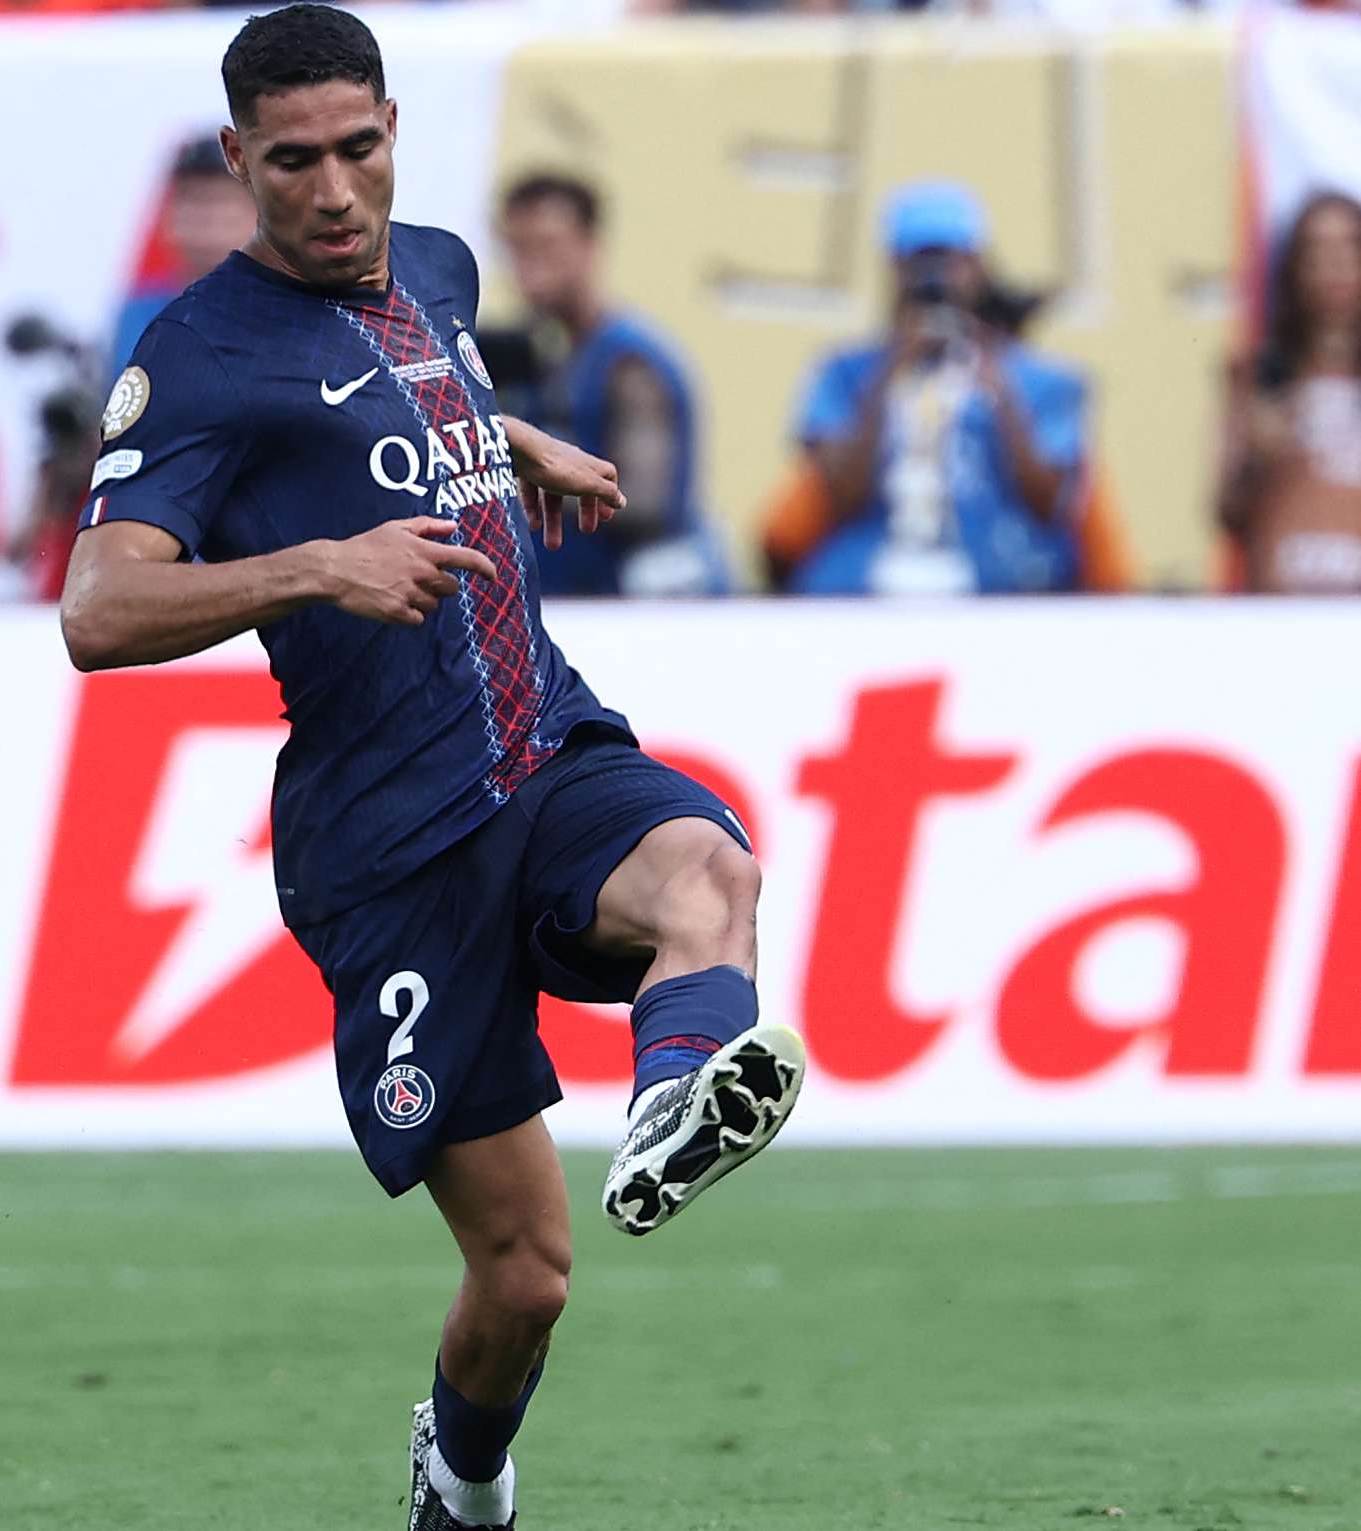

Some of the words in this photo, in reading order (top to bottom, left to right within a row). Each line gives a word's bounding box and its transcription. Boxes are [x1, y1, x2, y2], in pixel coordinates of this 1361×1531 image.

[435, 467, 518, 514] AIRWAY
[379, 970, 430, 1065] 2
[380, 1067, 417, 1091] PARIS
